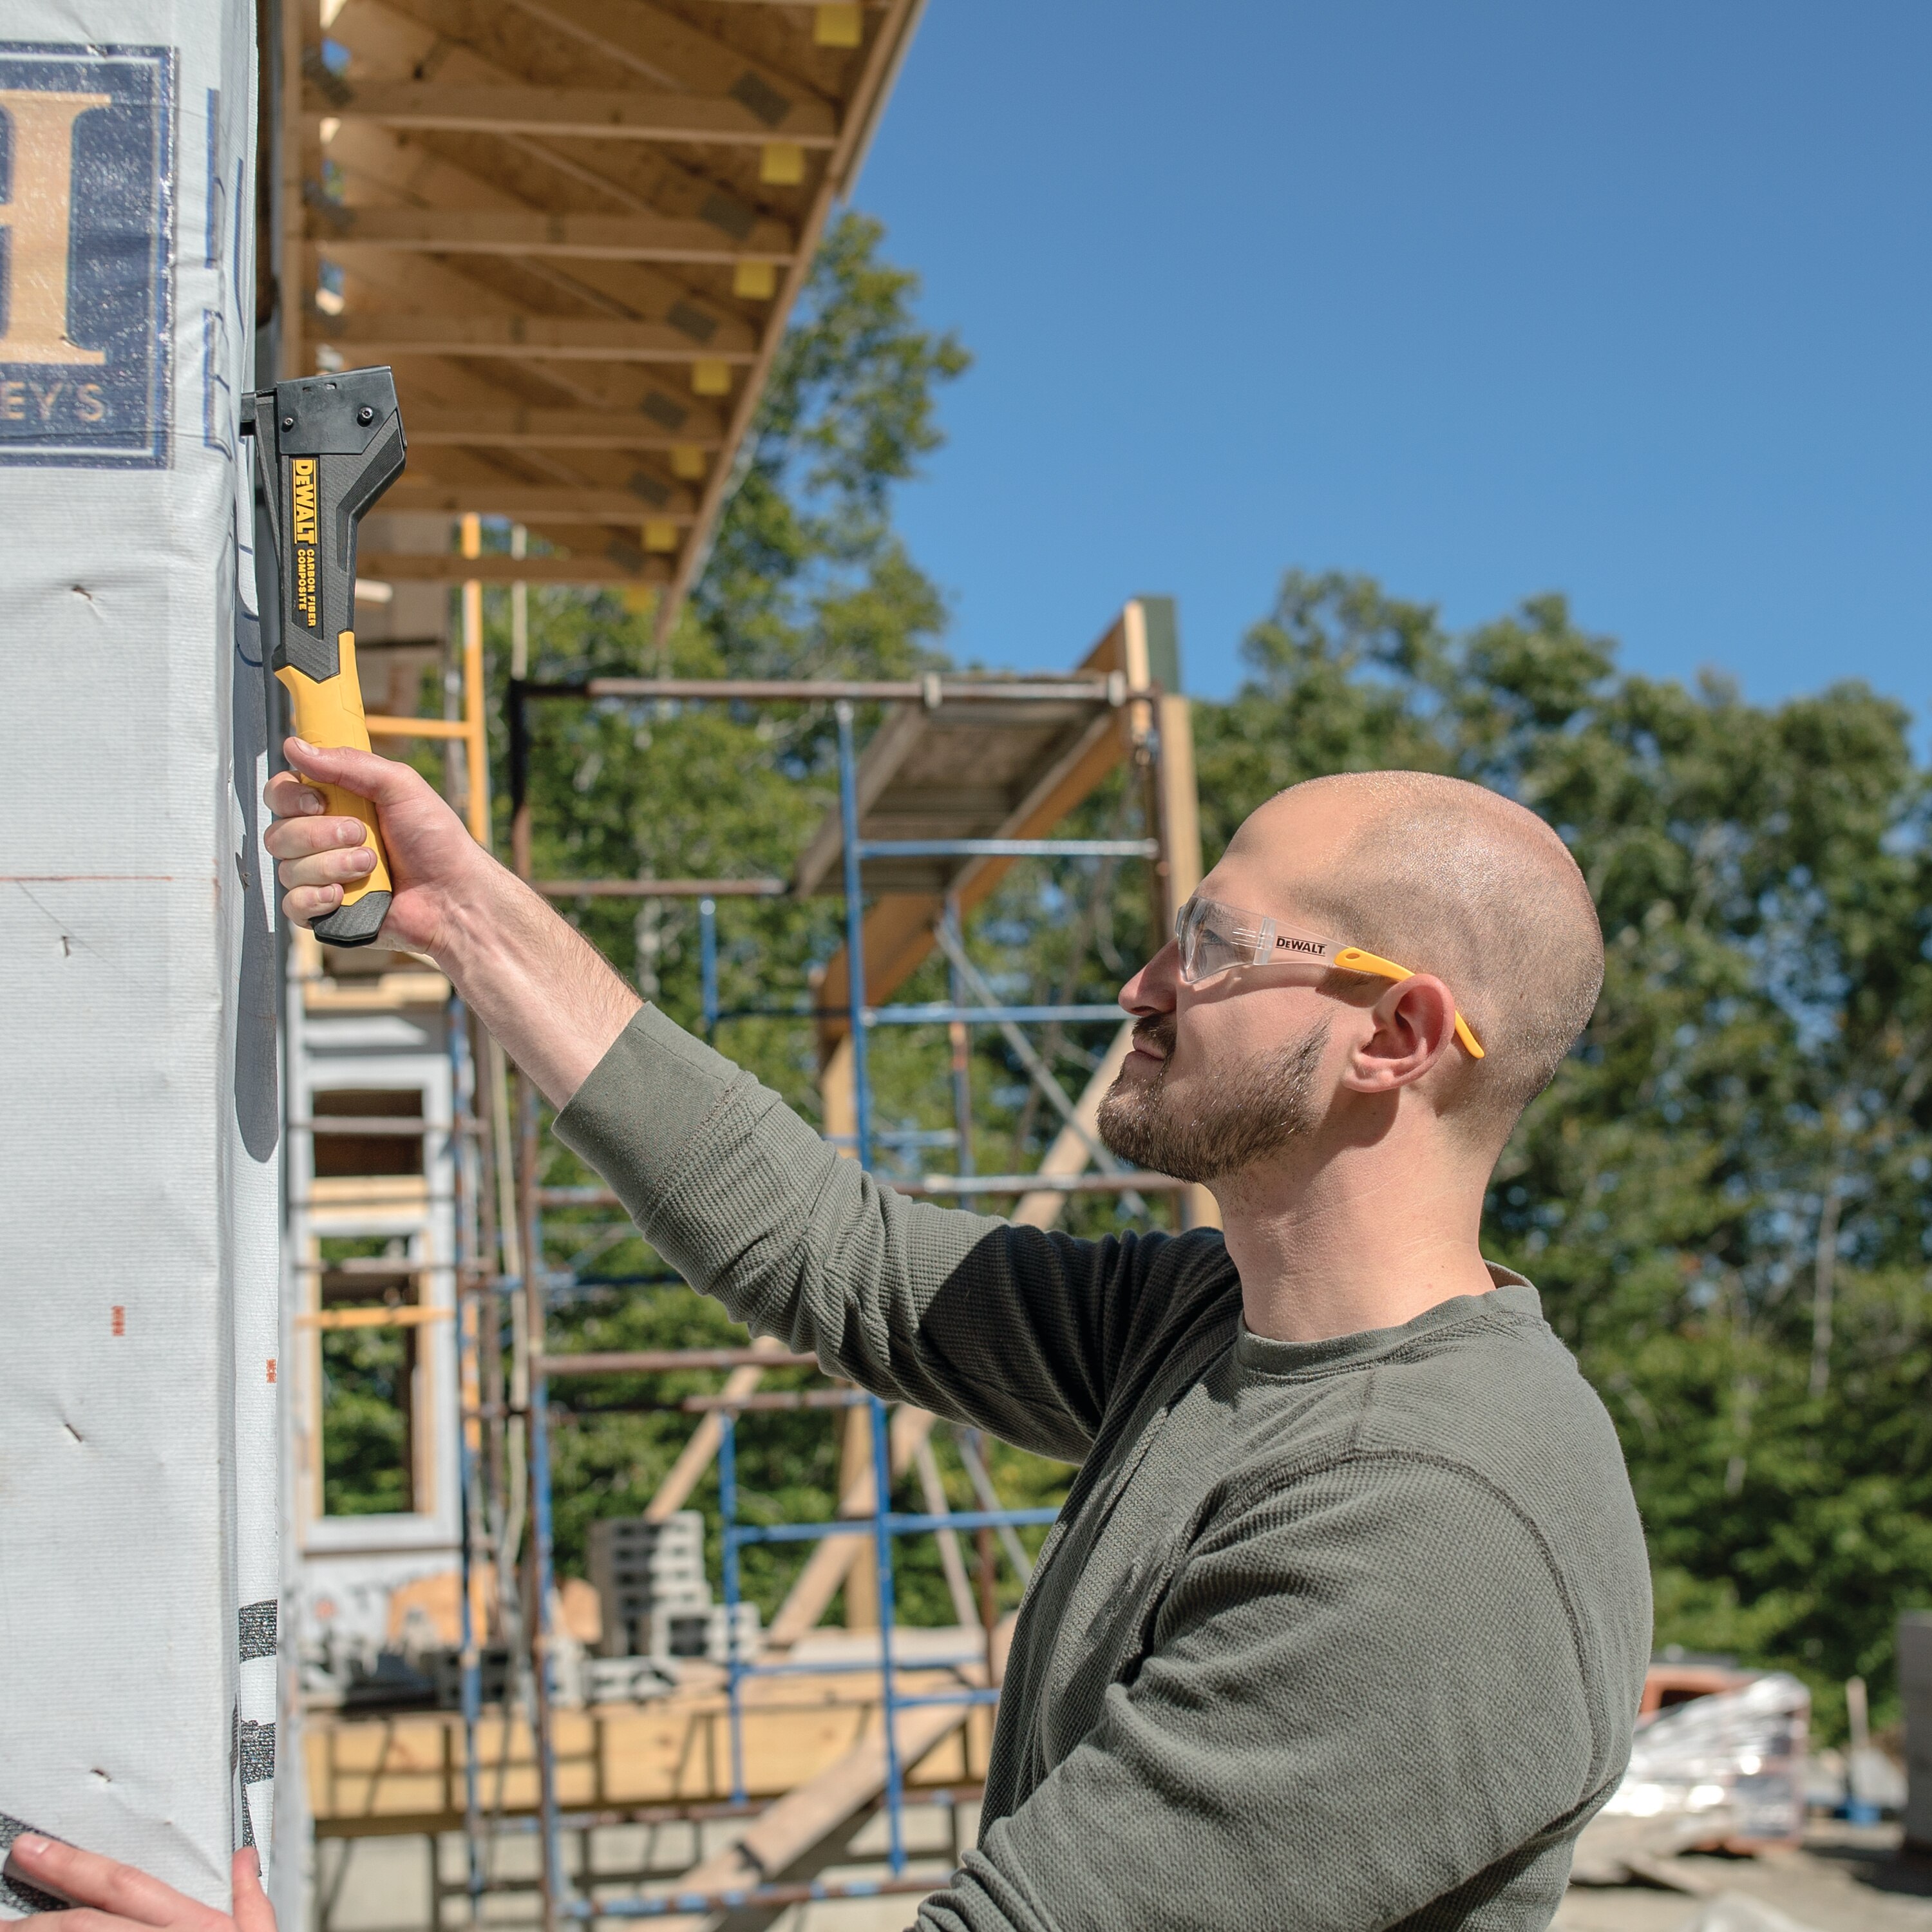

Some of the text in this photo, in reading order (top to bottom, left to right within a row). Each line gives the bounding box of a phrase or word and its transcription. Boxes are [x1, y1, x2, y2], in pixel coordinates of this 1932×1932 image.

[295, 459, 315, 544] DEWALT
[298, 549, 307, 611] COMPOSITE
[307, 549, 317, 627] CARBON FIBER
[1276, 937, 1325, 954] DEWALT
